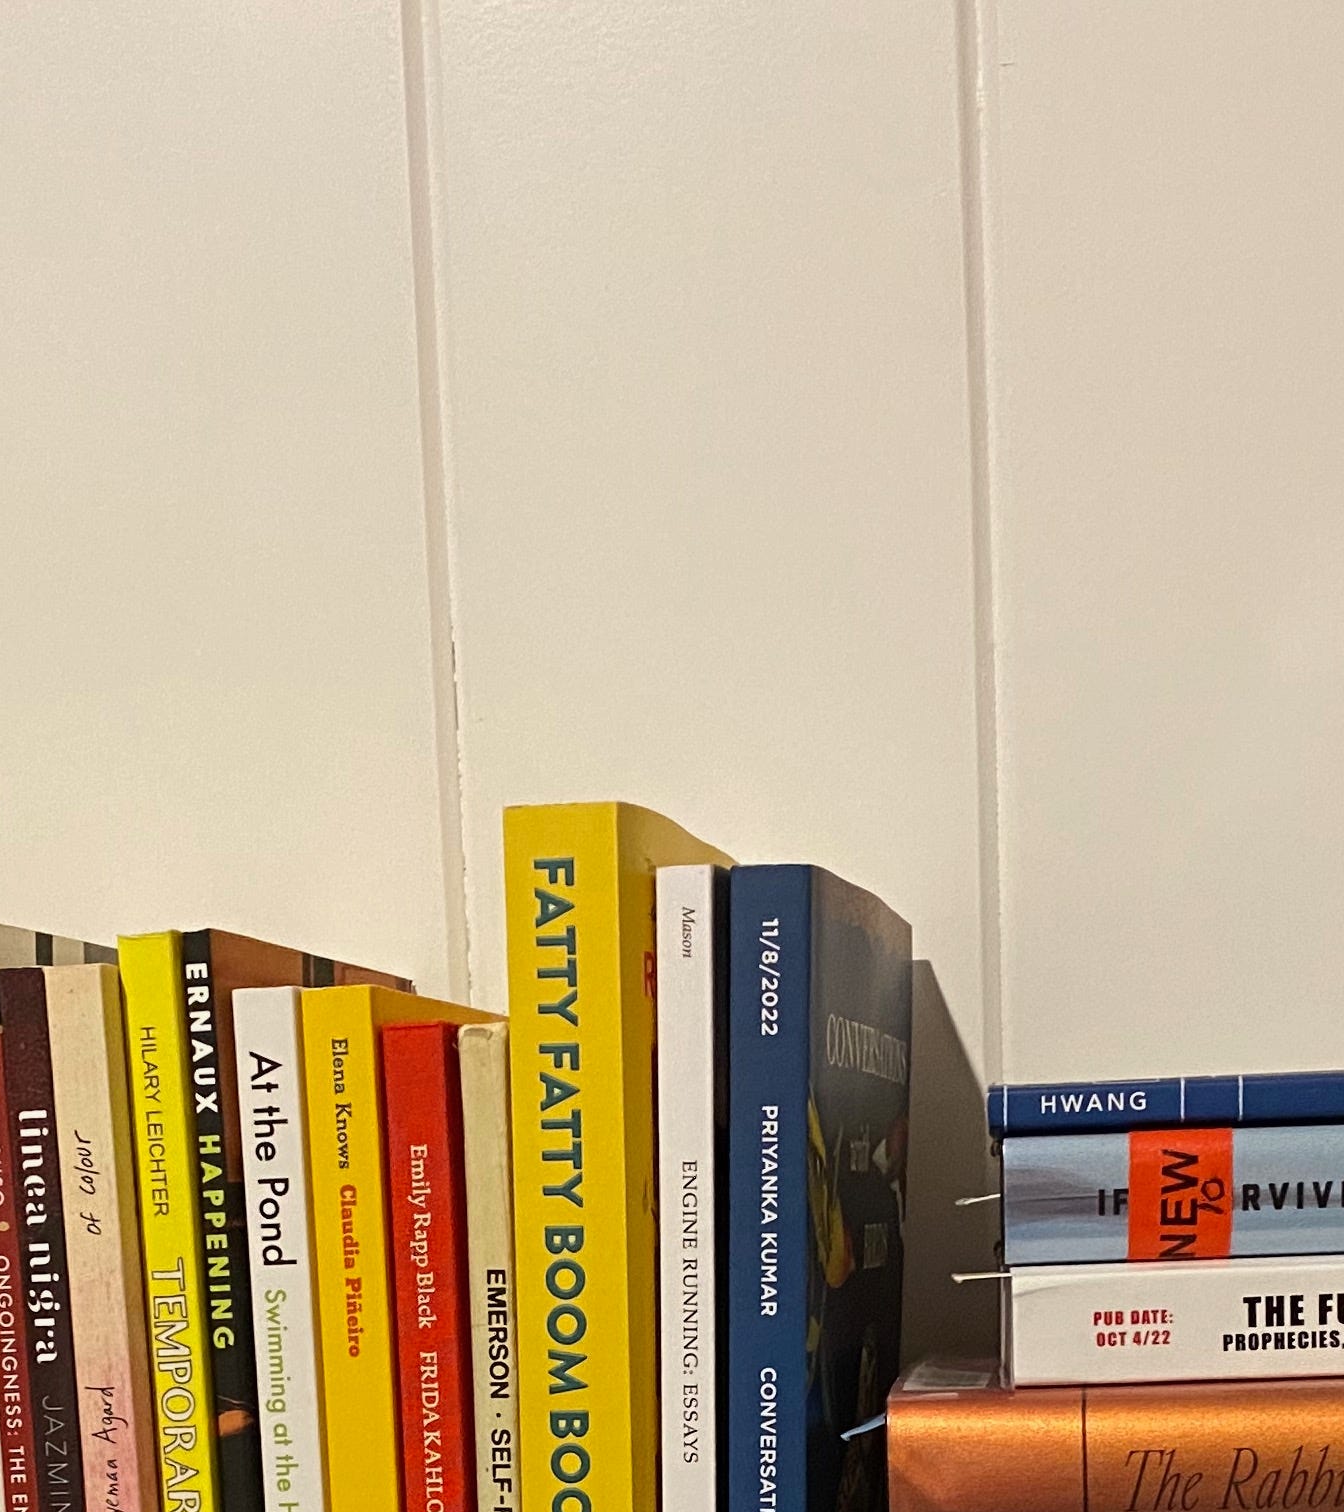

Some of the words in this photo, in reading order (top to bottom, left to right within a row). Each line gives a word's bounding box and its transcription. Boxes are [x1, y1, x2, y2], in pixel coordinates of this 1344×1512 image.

[533, 856, 580, 1028] FATTY
[681, 906, 694, 959] Mason
[760, 916, 780, 1037] 11/8/2022
[140, 1026, 161, 1104] HILARY
[185, 962, 219, 1114] ERNAUX
[249, 1051, 283, 1093] At
[331, 1037, 347, 1095] Elena
[253, 1106, 288, 1162] the
[335, 1101, 351, 1169] Knows
[538, 1041, 585, 1208] FATTY
[1040, 1091, 1148, 1115] HWANG
[19, 1108, 49, 1227] linea
[146, 1109, 170, 1217] LEICHTER
[407, 1144, 432, 1208] Emily
[682, 1160, 698, 1250] ENGINE
[760, 1105, 779, 1226] PRIYANKA
[199, 1134, 235, 1350] HAPPENING
[257, 1177, 297, 1266] Pond
[338, 1184, 356, 1270] Claudia
[410, 1212, 432, 1267] Rapp
[28, 1242, 60, 1364] nigra
[344, 1275, 361, 1358] Piñeiro
[416, 1271, 438, 1329] Black
[544, 1225, 589, 1396] BOOM
[682, 1256, 699, 1377] RUNNING:
[759, 1231, 778, 1317] KUMAR
[1243, 1295, 1305, 1329] THE
[486, 1268, 510, 1399] EMERSON
[1093, 1310, 1125, 1327] PUB
[1130, 1309, 1175, 1326] DATE:
[1095, 1331, 1128, 1348] OCT
[1132, 1330, 1172, 1347] 4/22
[682, 1383, 699, 1464] ESSAYS
